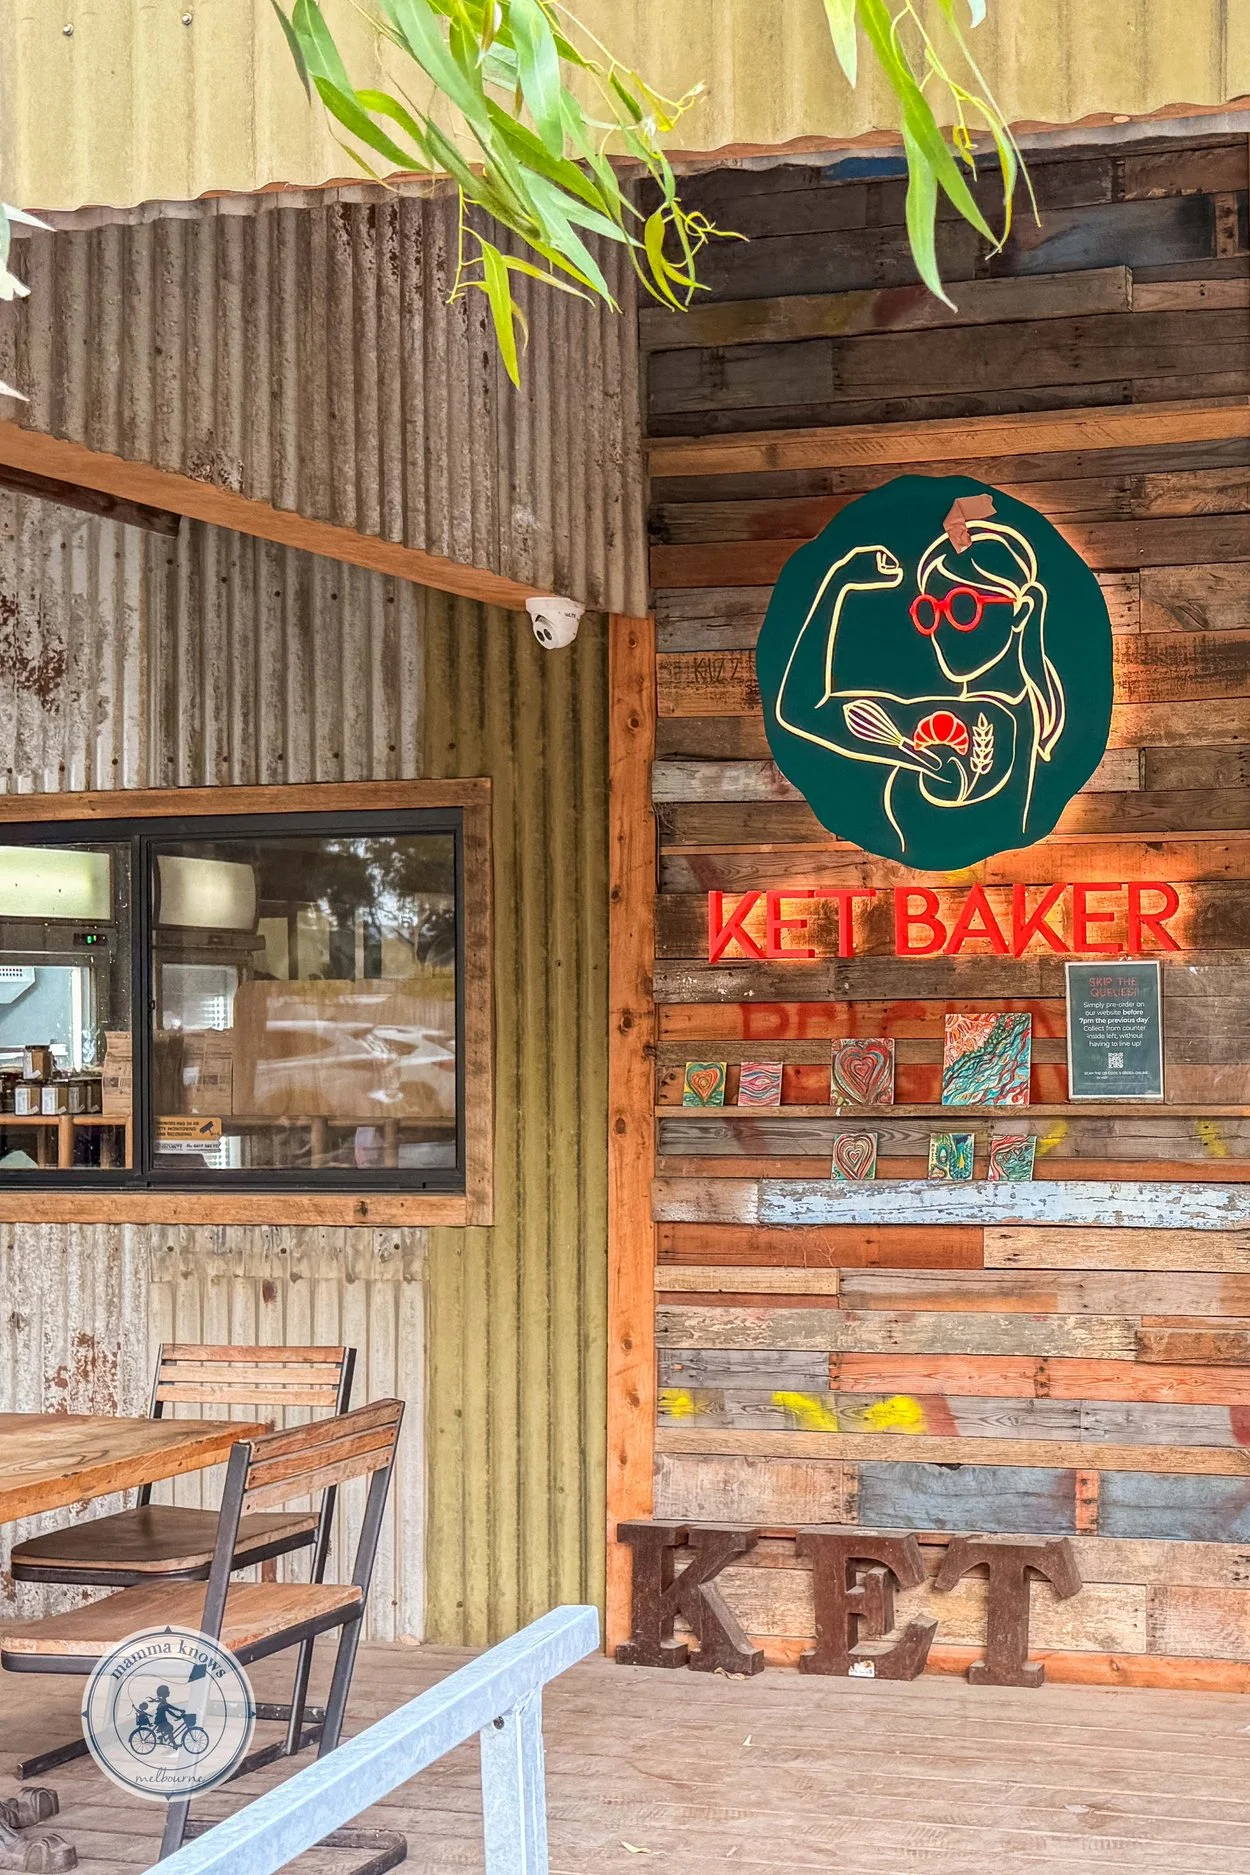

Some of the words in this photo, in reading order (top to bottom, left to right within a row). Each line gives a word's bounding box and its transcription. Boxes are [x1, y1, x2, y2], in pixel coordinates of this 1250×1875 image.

[707, 887, 876, 964] KET
[895, 880, 1180, 959] BAKER
[1089, 977, 1113, 987] SKIP
[1116, 977, 1137, 987] THE
[1090, 987, 1137, 998] QUEUES!
[1083, 1001, 1105, 1009] Simply
[1106, 1001, 1135, 1009] pre-order
[1107, 1017, 1135, 1025] previous
[615, 1519, 1083, 1688] KET
